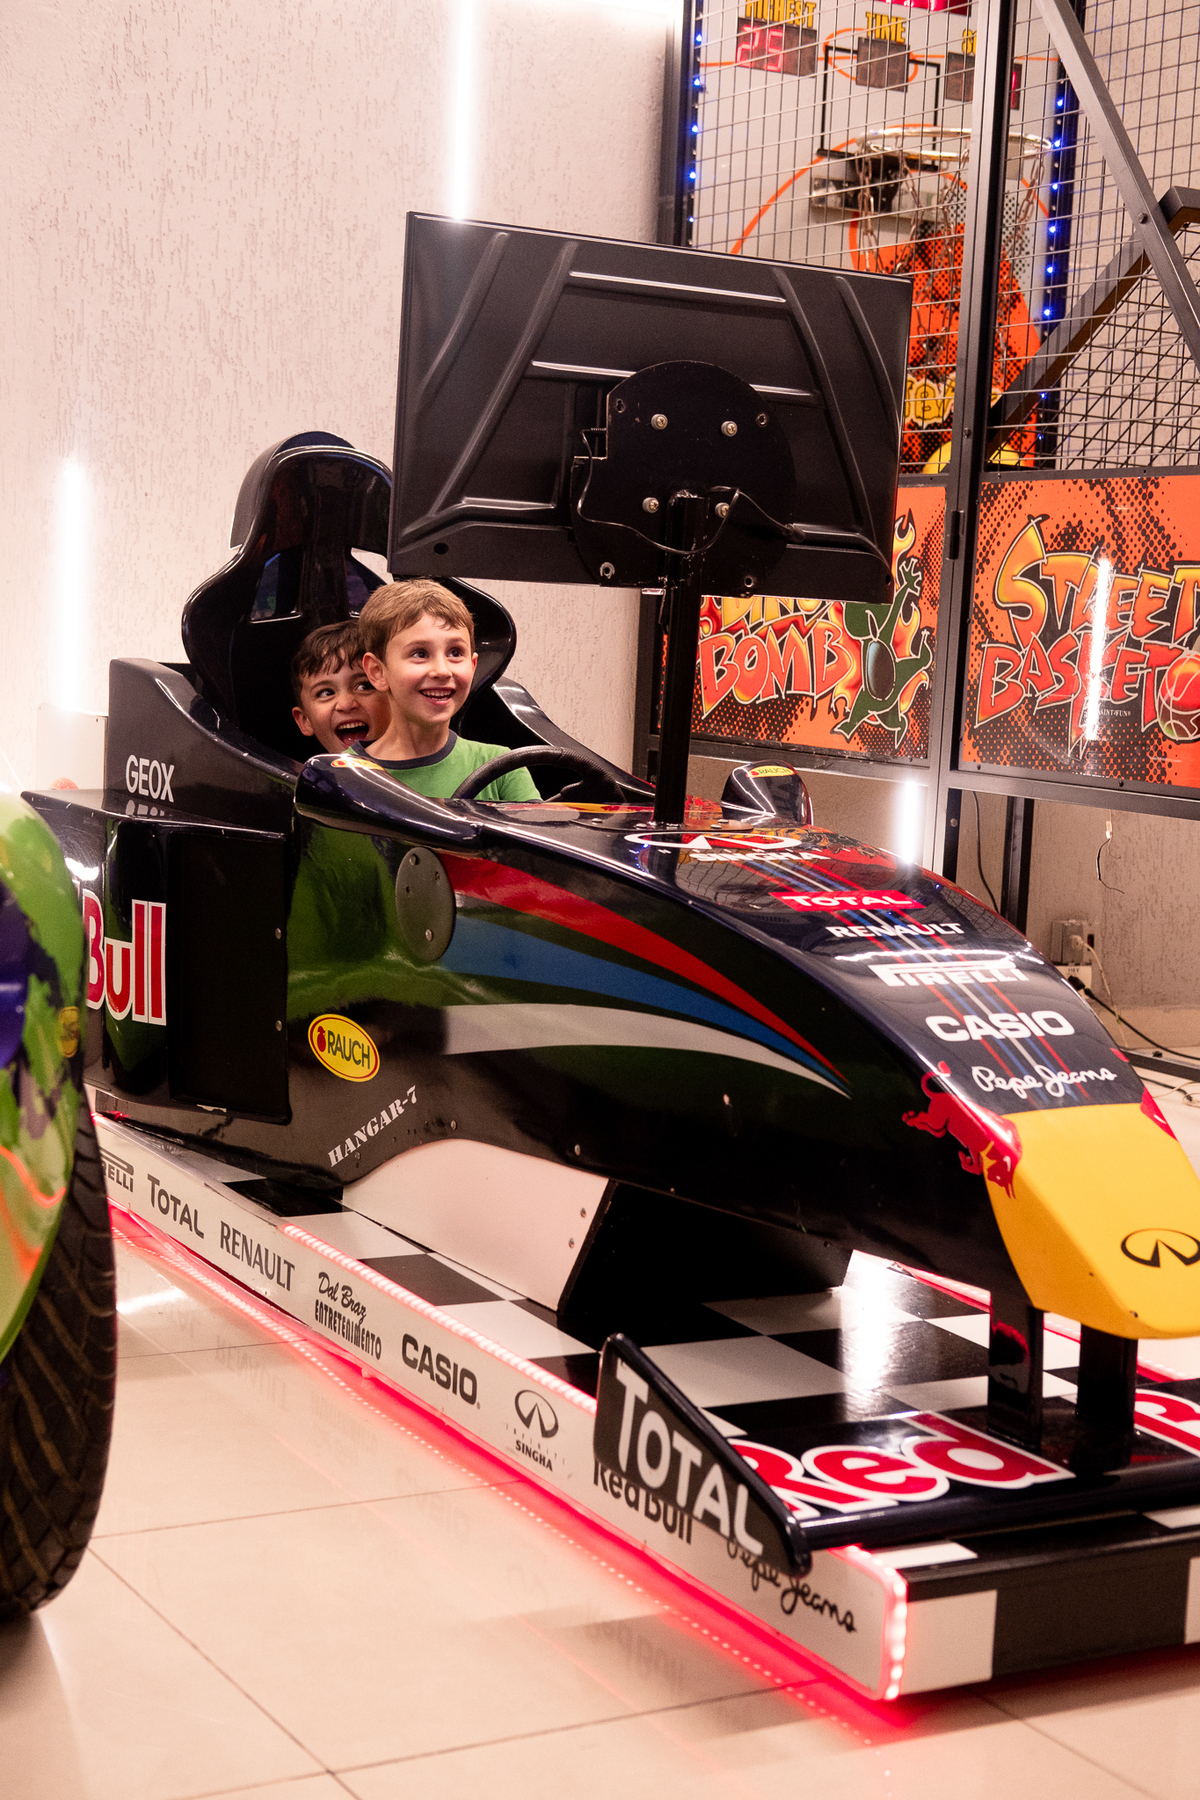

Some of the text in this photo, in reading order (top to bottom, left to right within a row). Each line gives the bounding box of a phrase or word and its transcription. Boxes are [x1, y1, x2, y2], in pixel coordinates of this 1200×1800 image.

[865, 12, 907, 43] TIME
[698, 618, 853, 720] BOMB
[125, 754, 175, 803] GEOX
[782, 895, 913, 907] TOTAL
[825, 922, 965, 938] RENAULT
[83, 888, 167, 1026] Bull
[868, 959, 1030, 987] PIRELLI
[328, 1029, 371, 1069] RAUCH
[925, 1010, 1075, 1042] CASIO
[971, 1064, 1117, 1099] Pepe Jeans
[328, 1085, 418, 1168] HANGAR-7
[147, 1173, 205, 1239] TOTAL
[220, 1220, 296, 1292] RENAULT
[318, 1271, 367, 1326] Dal Braz
[315, 1299, 382, 1361] ENTRETENIMENTO
[402, 1333, 478, 1406] CASIO
[515, 1439, 553, 1472] SINGHA
[615, 1356, 764, 1557] TOTAL
